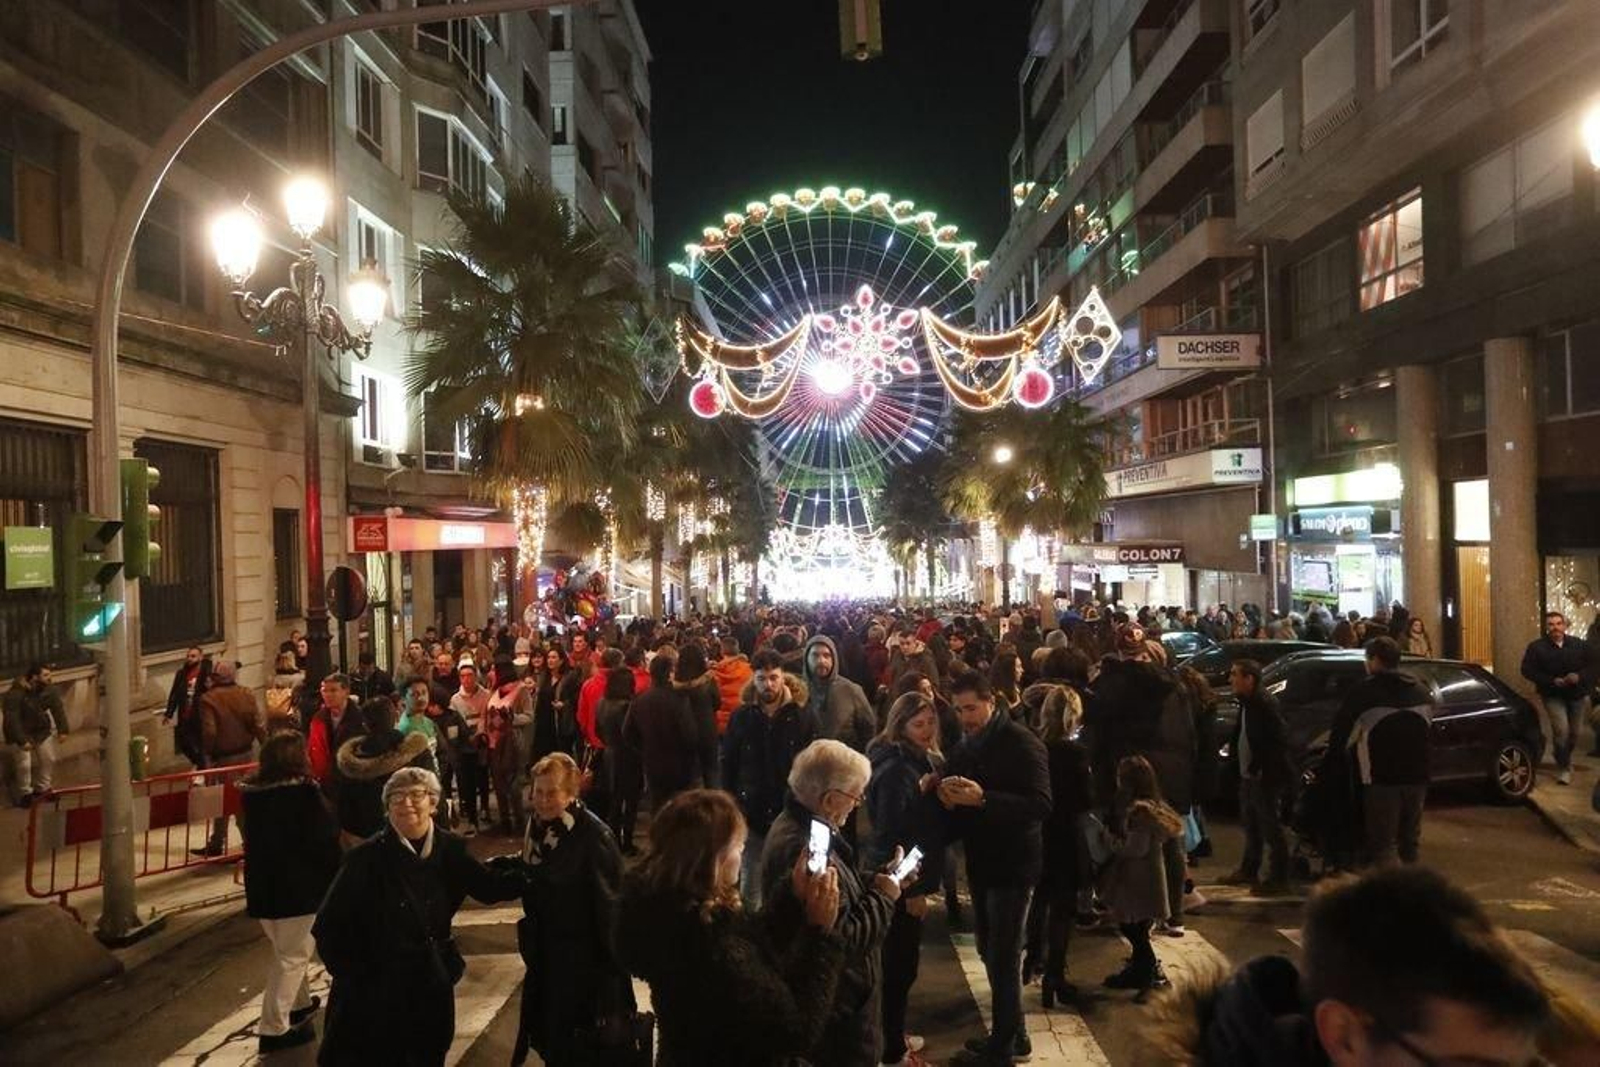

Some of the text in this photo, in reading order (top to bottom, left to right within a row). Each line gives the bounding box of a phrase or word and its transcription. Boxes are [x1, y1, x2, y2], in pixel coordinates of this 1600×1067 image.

[1178, 341, 1240, 354] DACHSER
[1123, 462, 1167, 483] PREVENTIVA
[1214, 468, 1261, 476] PREVENTIVA
